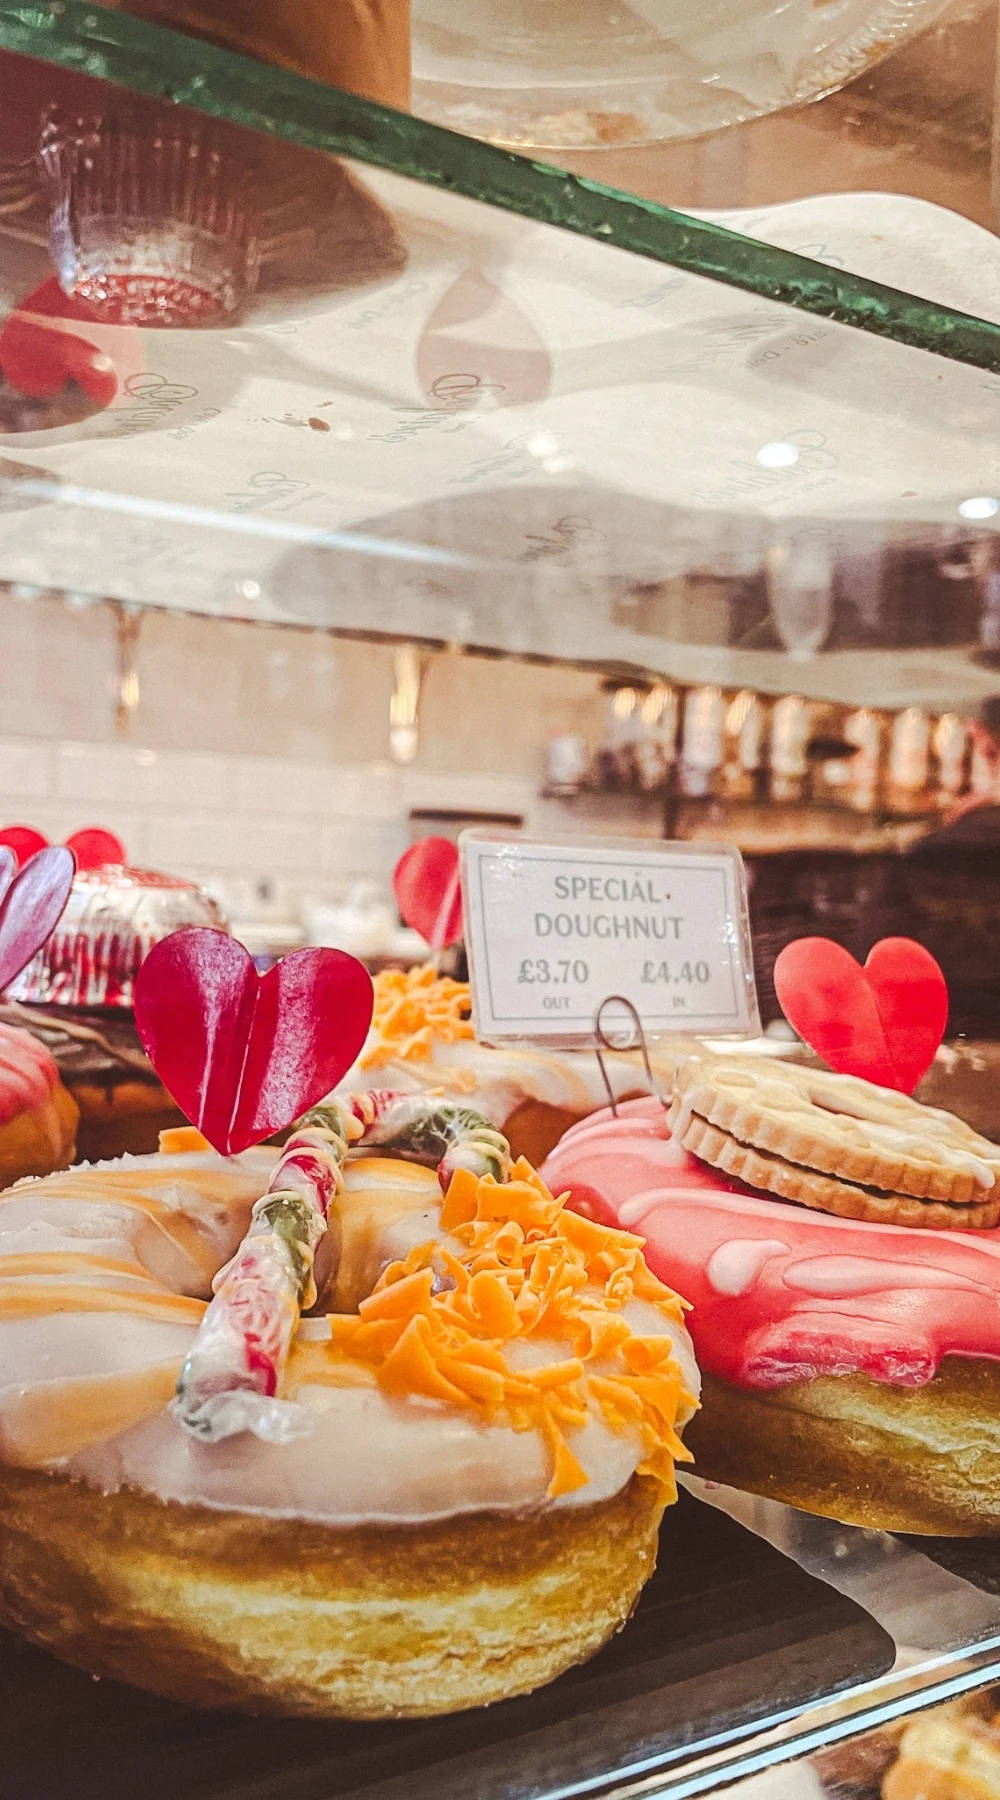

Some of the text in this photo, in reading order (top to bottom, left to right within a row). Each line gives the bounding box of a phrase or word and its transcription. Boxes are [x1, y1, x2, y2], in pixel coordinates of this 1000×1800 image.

[554, 875, 662, 904] SPECIAL
[534, 912, 685, 940] DOUGHNUT
[516, 958, 590, 985] £3.70
[640, 959, 711, 985] £4.40
[543, 996, 571, 1010] OUT
[672, 995, 686, 1008] IN
